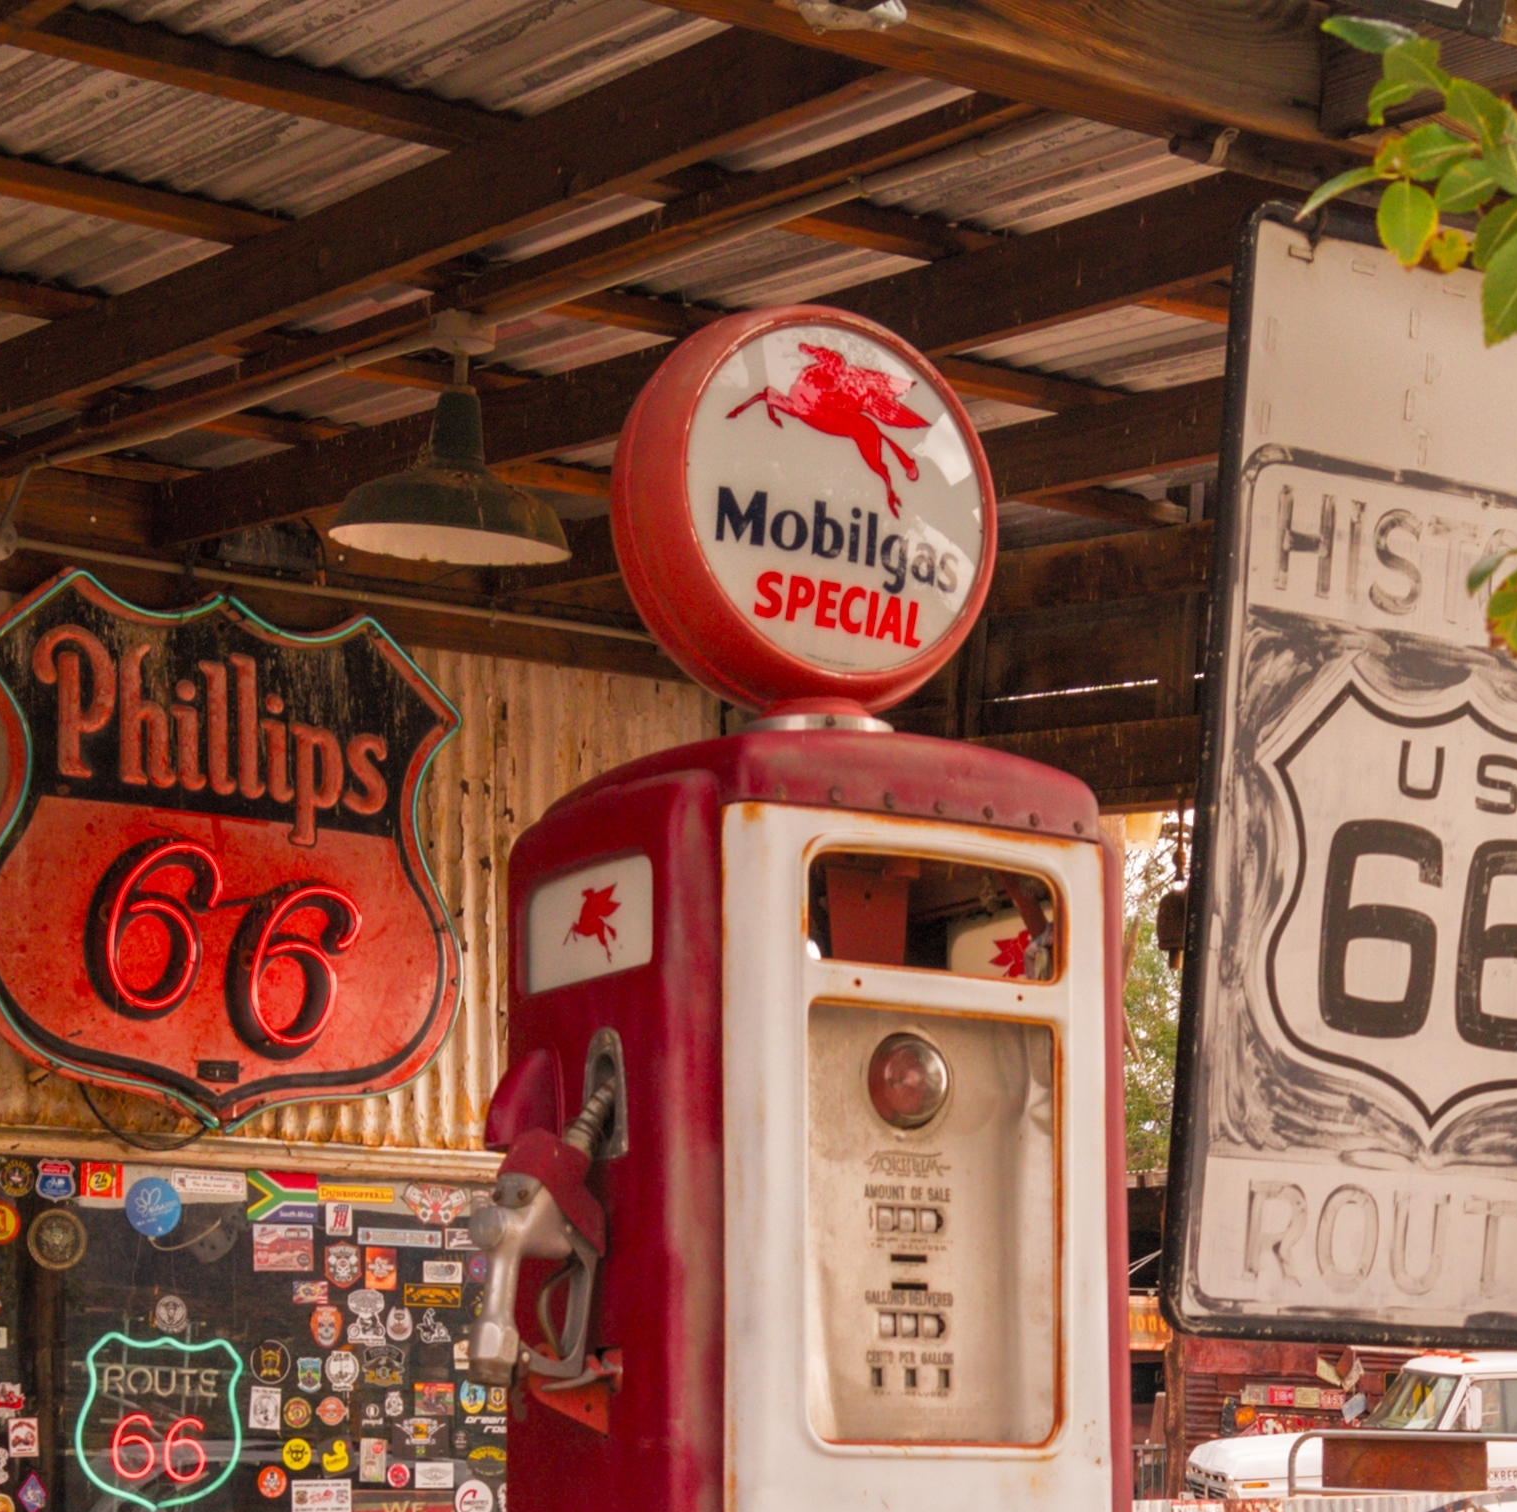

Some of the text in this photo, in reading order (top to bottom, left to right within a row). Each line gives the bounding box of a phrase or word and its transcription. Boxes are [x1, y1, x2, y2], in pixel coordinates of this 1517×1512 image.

[715, 486, 960, 594] Mobilgas
[753, 571, 922, 649] SPECIAL
[33, 624, 389, 847] Phillips
[83, 836, 362, 1061] 66
[864, 1183, 951, 1203] AMOUNT OF SALE
[865, 1289, 954, 1307] GALLONS DELIVERED
[103, 1364, 219, 1398] ROUTE
[921, 1352, 954, 1365] GALLON
[111, 1413, 206, 1483] 66
